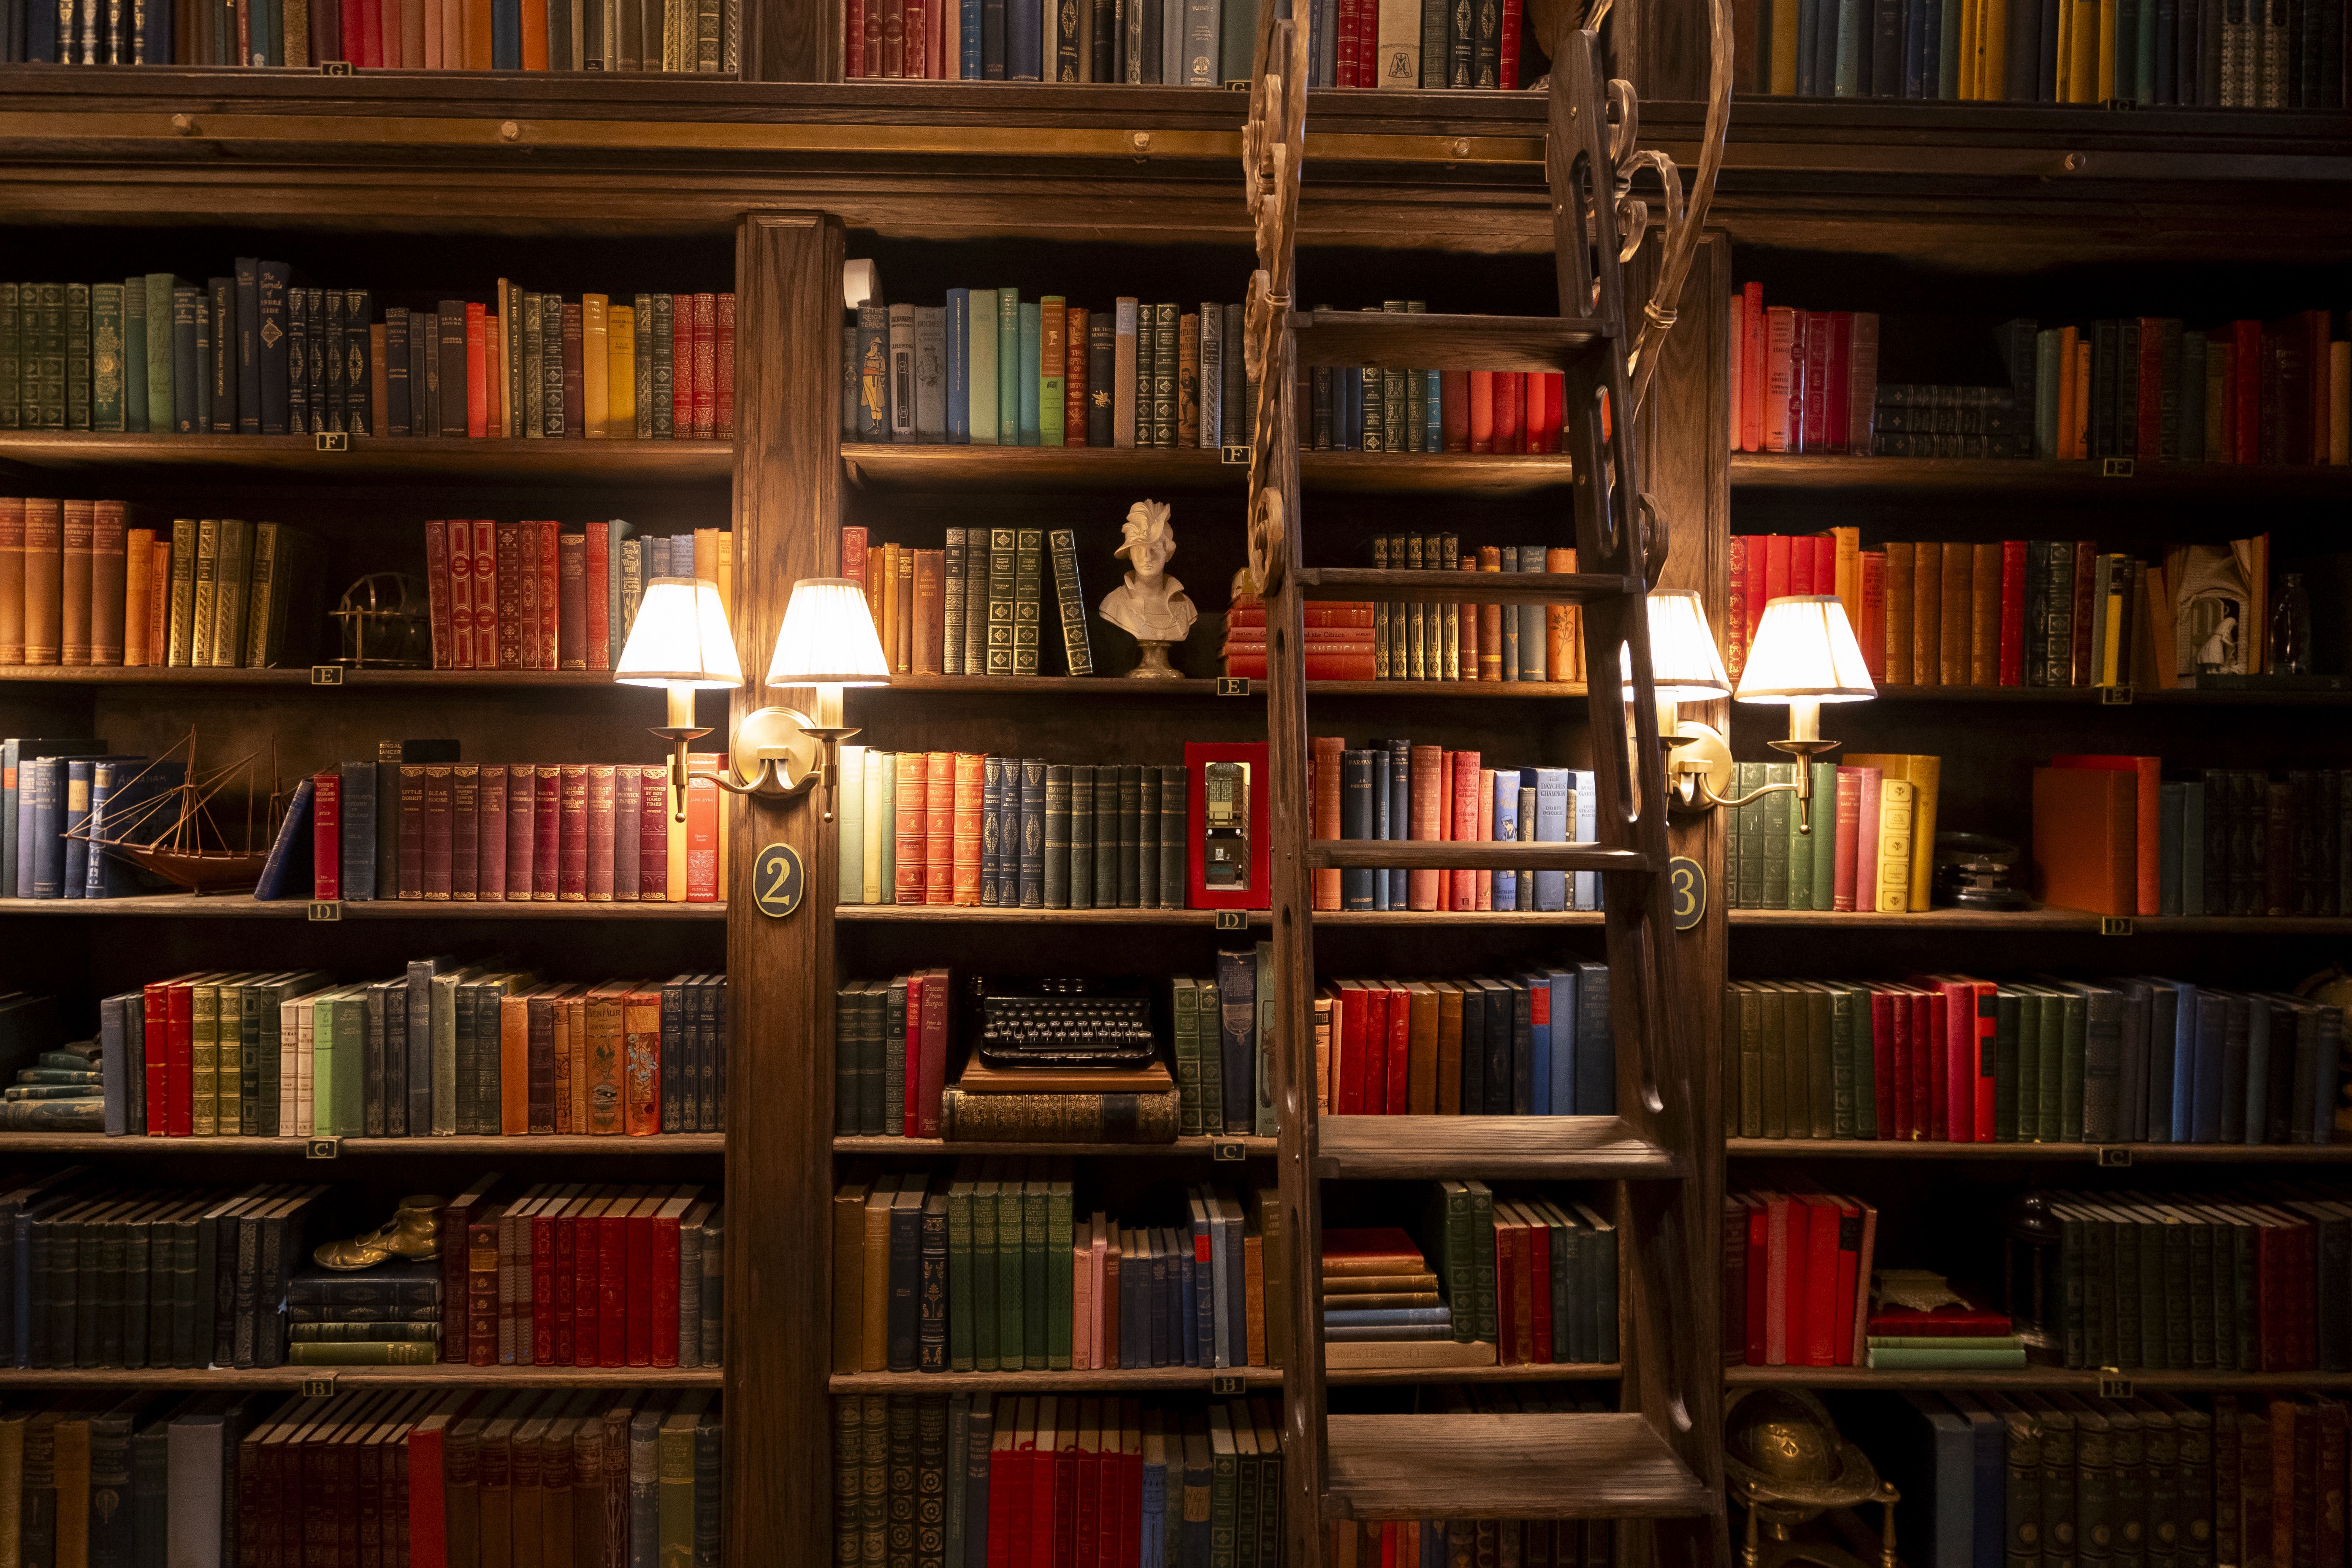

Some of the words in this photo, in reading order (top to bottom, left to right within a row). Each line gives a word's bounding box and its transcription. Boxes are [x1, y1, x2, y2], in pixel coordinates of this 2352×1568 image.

[329, 65, 343, 76] G
[325, 435, 338, 449] F
[1230, 447, 1243, 461] F
[2114, 461, 2126, 474] F
[321, 669, 333, 683] E
[1226, 679, 1240, 693] E
[2113, 688, 2124, 702] E
[761, 857, 790, 905] 2
[1671, 869, 1696, 915] 3
[317, 905, 331, 918] D
[1225, 913, 1239, 927] D
[2111, 920, 2124, 933] D
[924, 1000, 944, 1009] Burgos
[314, 1143, 329, 1156] C
[1222, 1145, 1237, 1159] C
[2110, 1151, 2123, 1164] C
[1330, 1348, 1362, 1359] Natural
[1404, 1348, 1414, 1359] of
[312, 1382, 325, 1395] B
[1222, 1378, 1236, 1392] B
[2112, 1381, 2123, 1394] B
